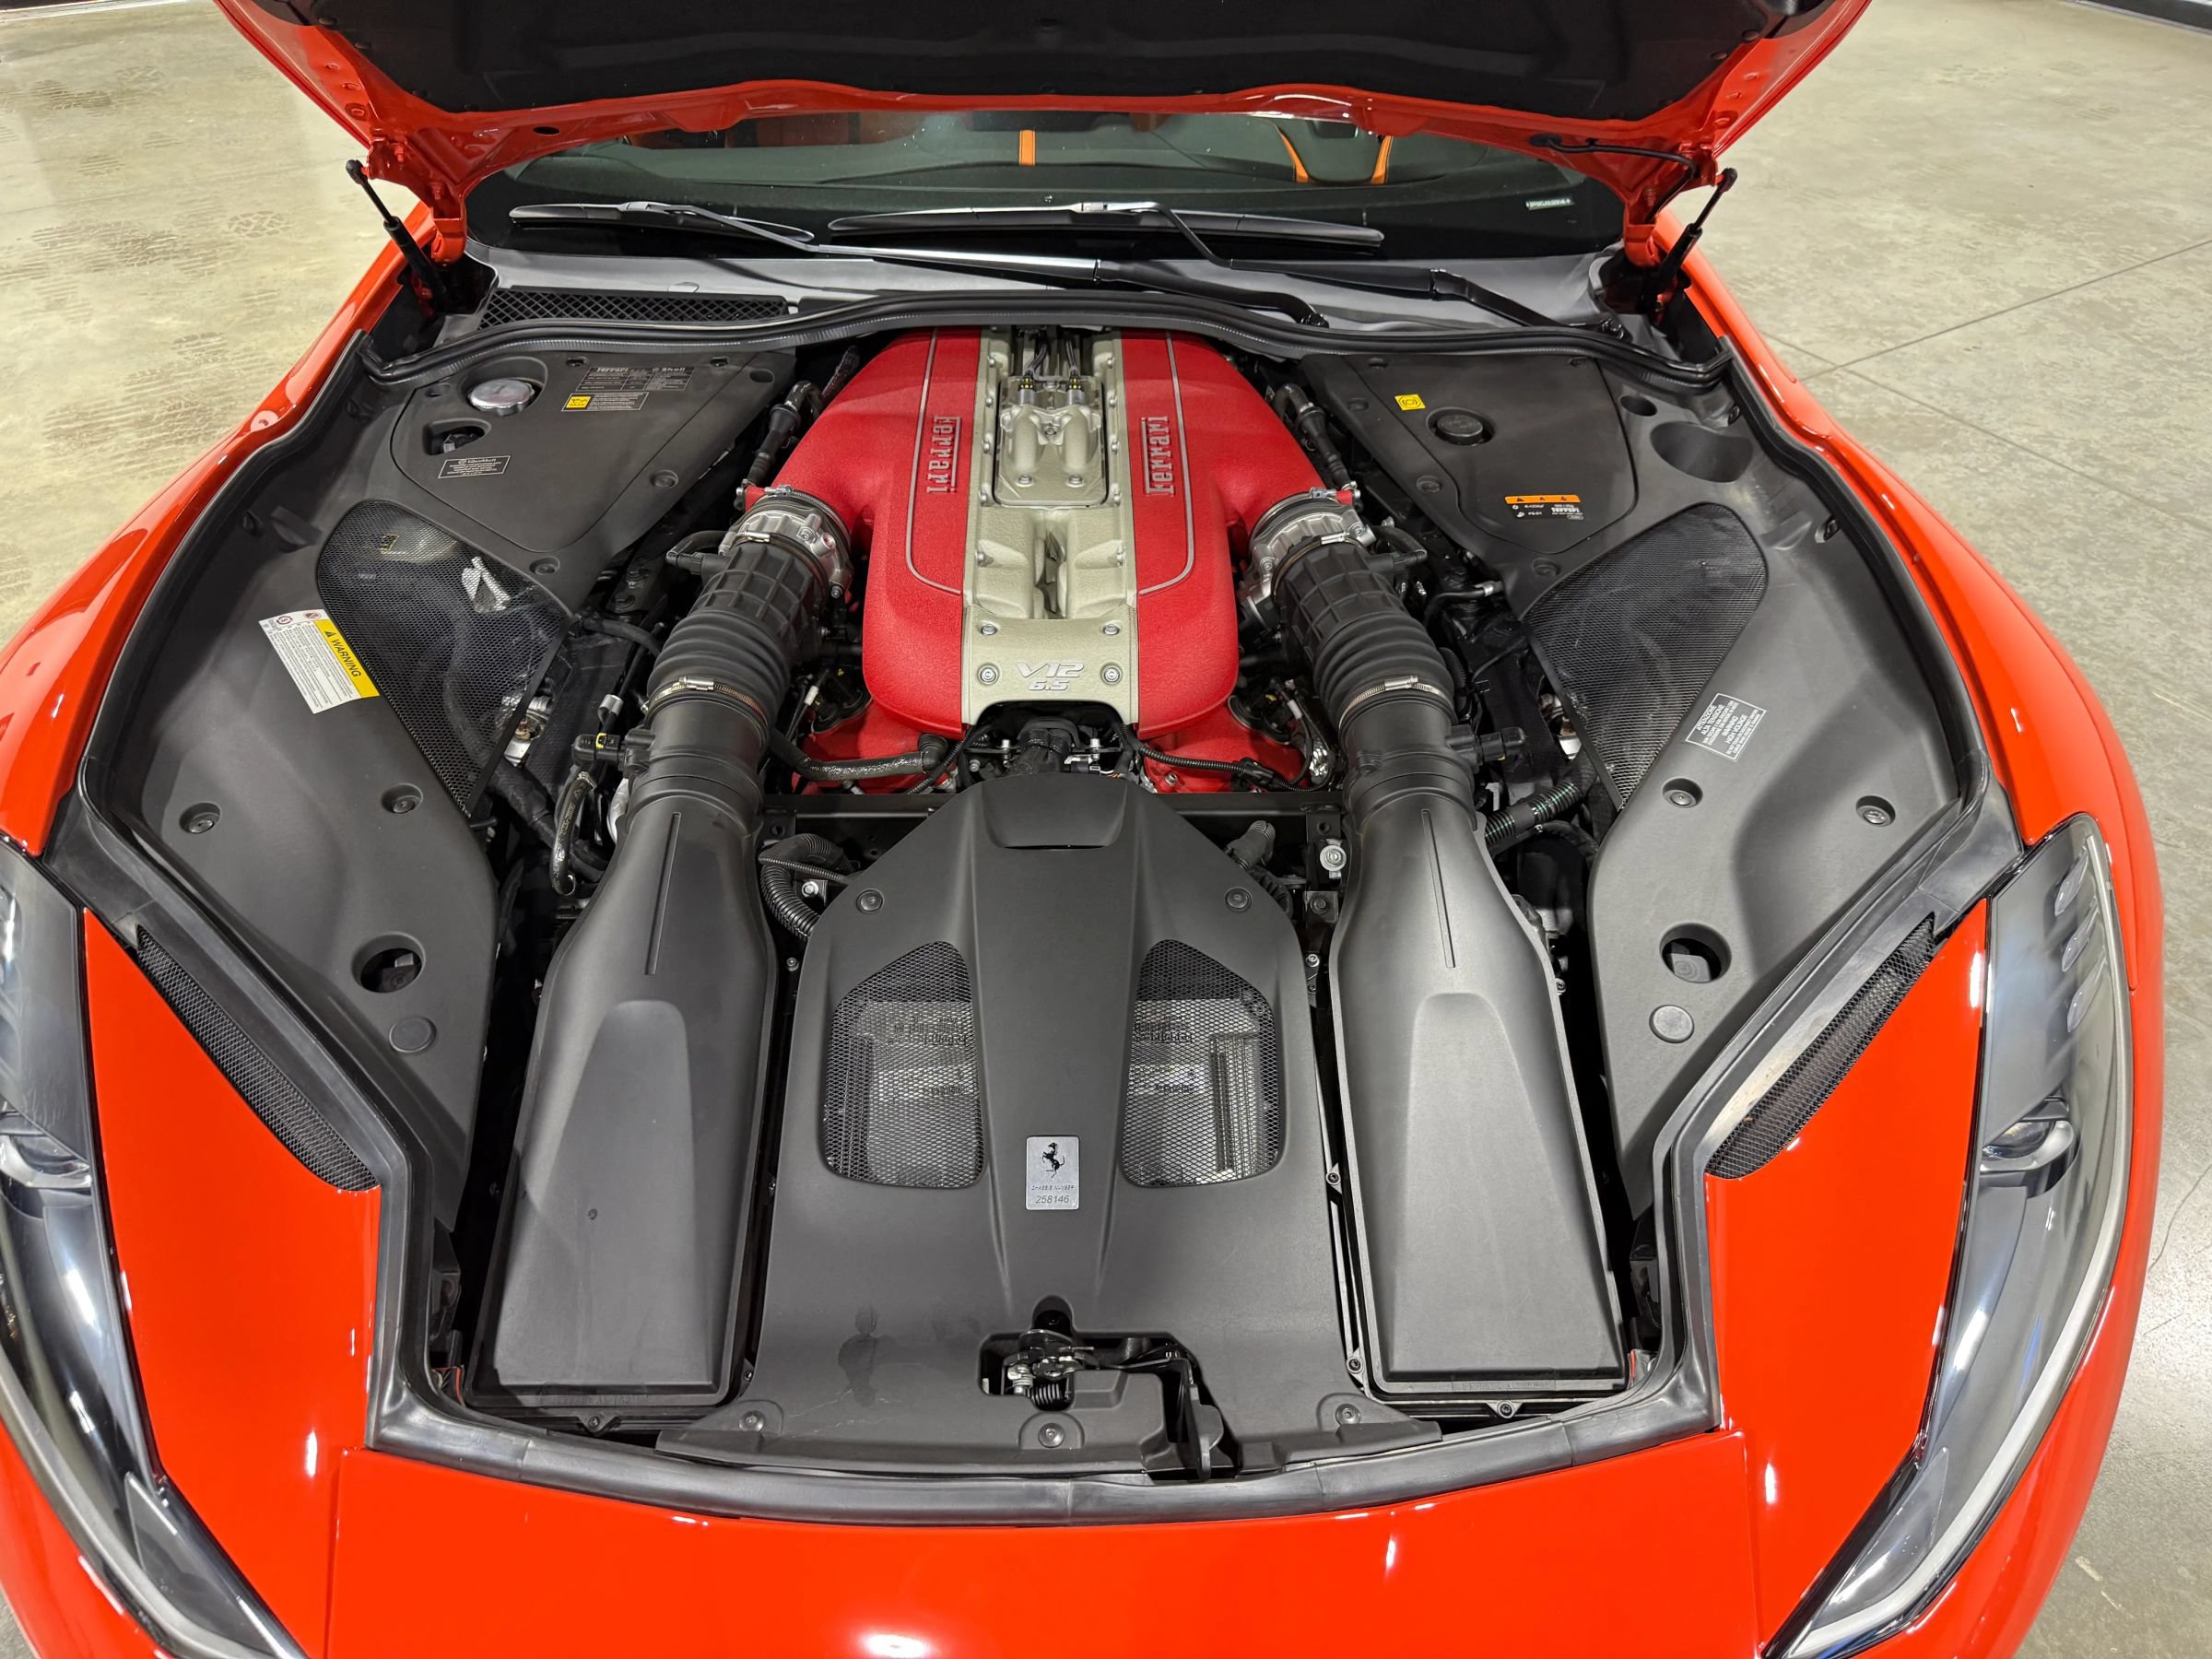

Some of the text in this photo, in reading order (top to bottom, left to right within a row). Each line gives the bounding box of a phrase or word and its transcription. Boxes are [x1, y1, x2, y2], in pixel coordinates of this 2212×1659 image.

[926, 414, 960, 494] Ferrari
[1141, 416, 1175, 496] Ferrari
[331, 639, 361, 677] WARNING
[1017, 662, 1084, 679] V12
[1029, 679, 1070, 691] 6.5
[1035, 1194, 1070, 1204] 258146
